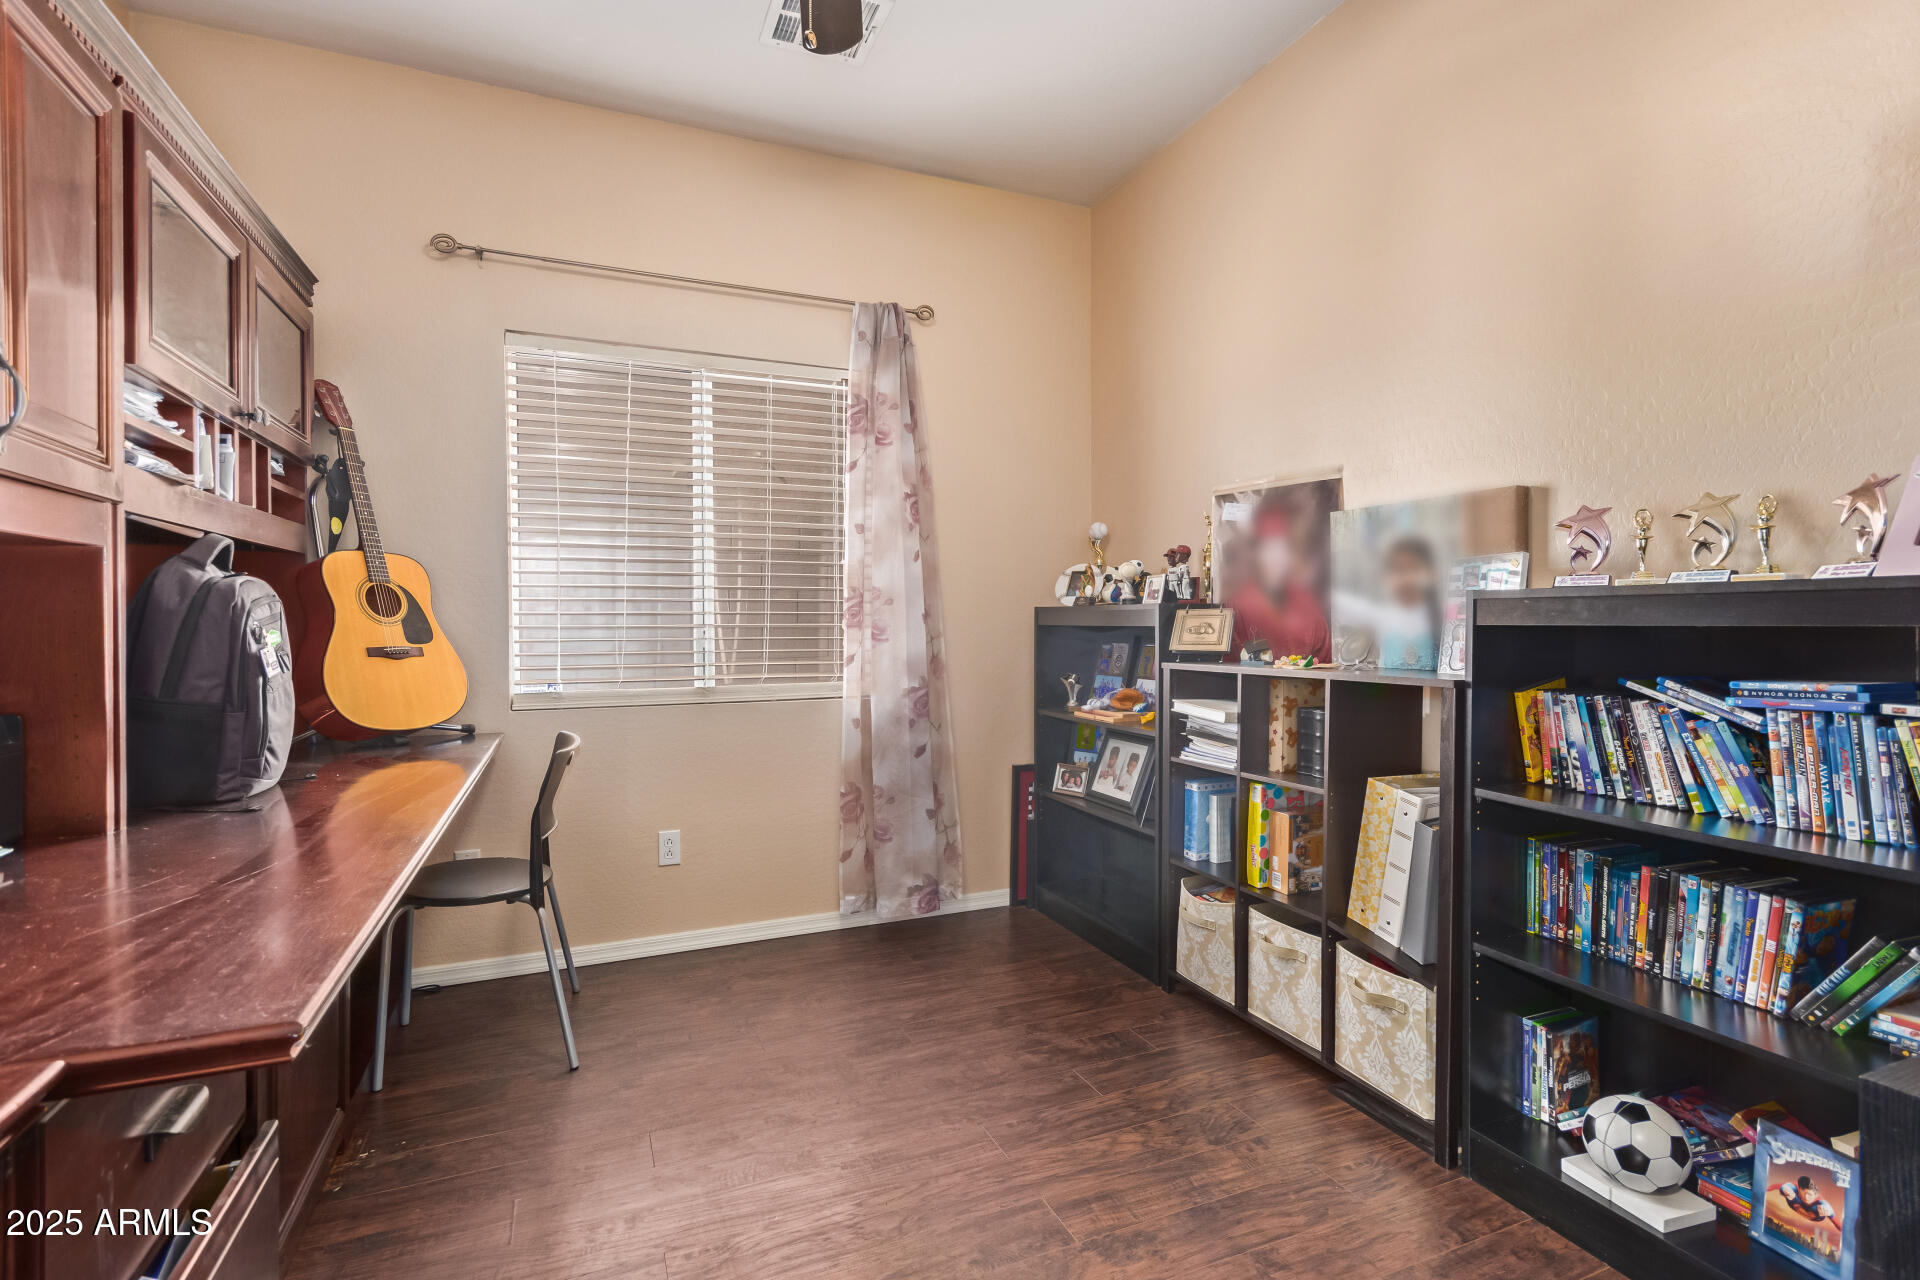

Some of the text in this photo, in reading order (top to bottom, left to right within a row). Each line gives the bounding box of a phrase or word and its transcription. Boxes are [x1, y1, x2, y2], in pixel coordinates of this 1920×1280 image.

[1626, 712, 1639, 746] HALO
[1614, 740, 1627, 771] G-FORCE
[1794, 723, 1807, 777] SPIDER-MAN
[1851, 720, 1863, 777] GREEN LANTERN
[1806, 745, 1821, 816] SPIDER-MAN
[1818, 763, 1831, 804] AVATAR
[1782, 953, 1794, 973] IGOR
[1816, 977, 1836, 996] KING
[1831, 965, 1851, 982] KONG
[1766, 1136, 1850, 1176] SUPERMAN
[1836, 1173, 1851, 1188] II
